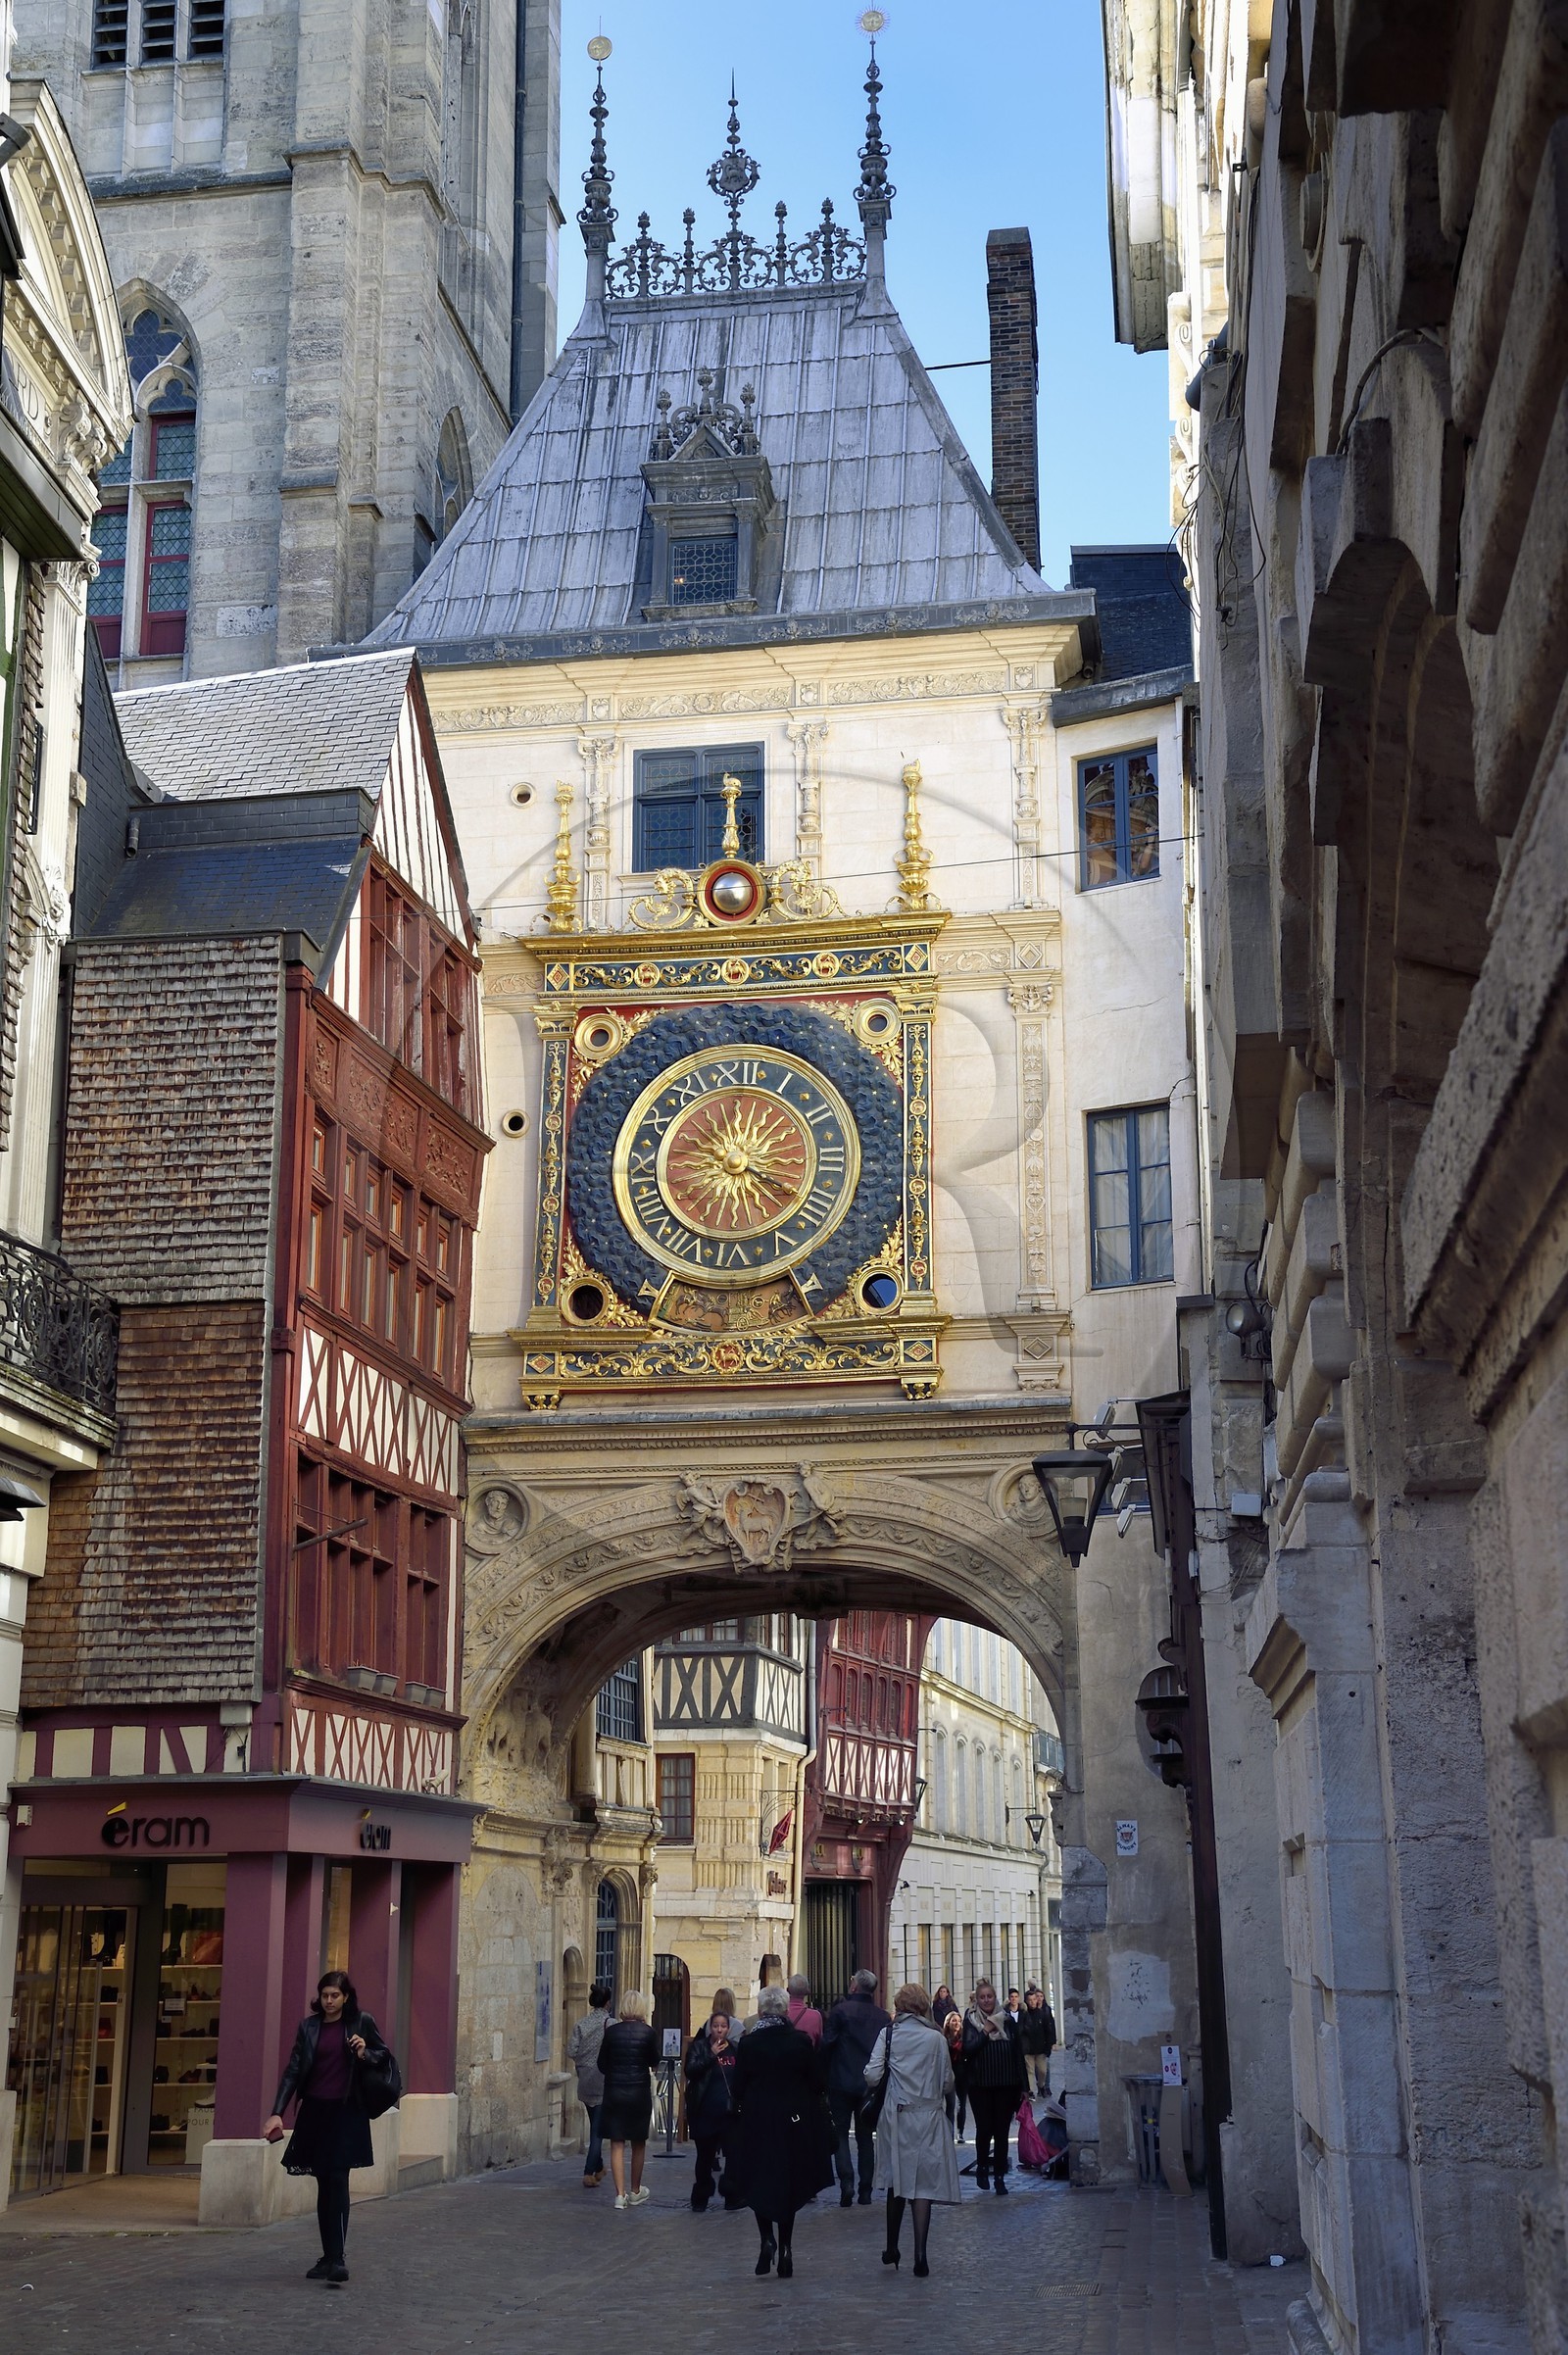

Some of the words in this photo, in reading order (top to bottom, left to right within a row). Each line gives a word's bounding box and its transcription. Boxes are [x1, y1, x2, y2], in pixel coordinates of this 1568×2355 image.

[715, 1061, 759, 1086] XII
[777, 1073, 793, 1093] I
[670, 1071, 709, 1107] XI
[641, 1106, 672, 1136] X
[805, 1103, 834, 1125] II
[630, 1152, 656, 1184] IX
[819, 1147, 844, 1173] III
[664, 1229, 703, 1263] VII
[773, 1231, 799, 1256] V
[102, 1801, 210, 1848] éram
